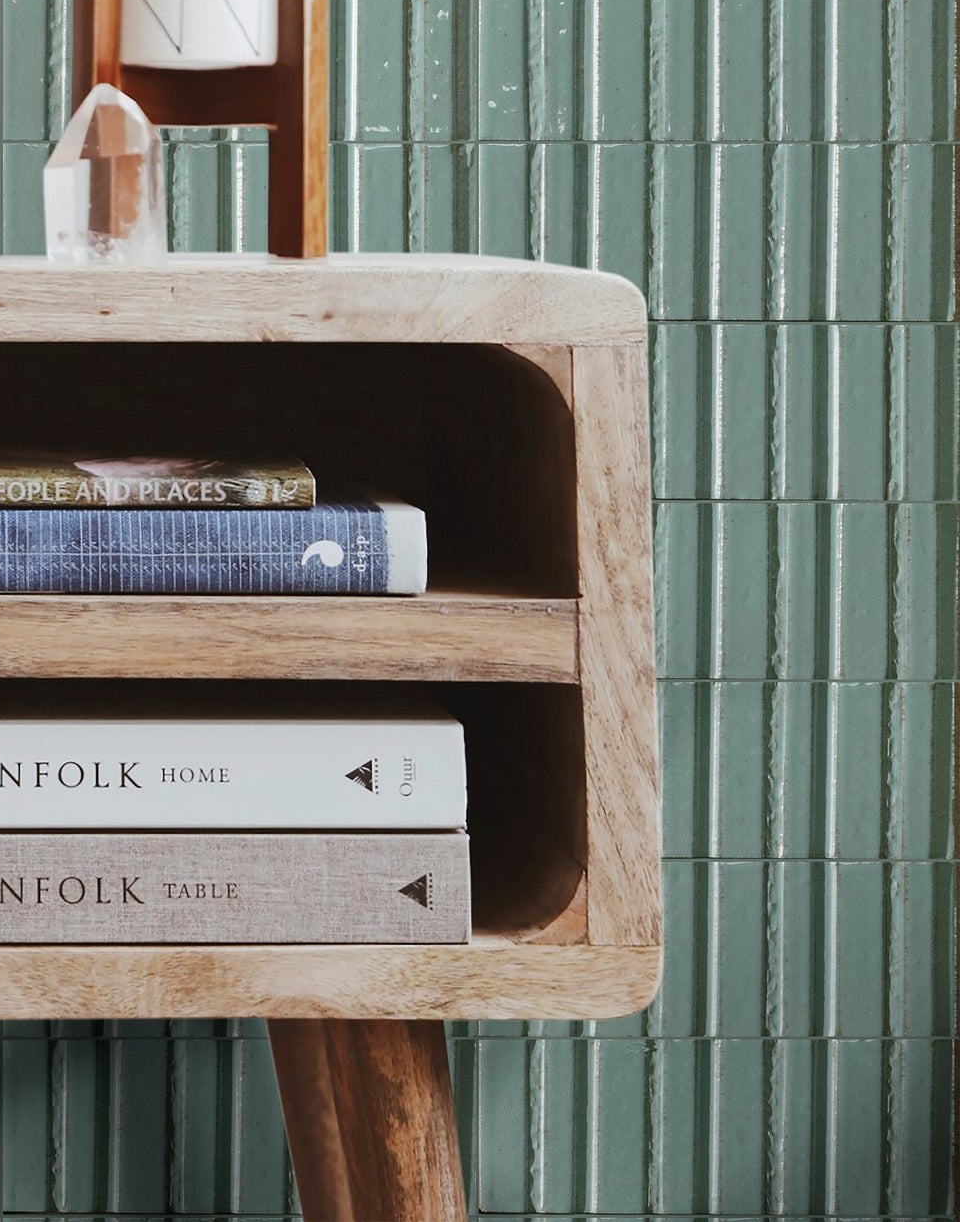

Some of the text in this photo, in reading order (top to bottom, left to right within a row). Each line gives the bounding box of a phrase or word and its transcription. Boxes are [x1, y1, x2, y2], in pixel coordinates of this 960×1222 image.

[75, 480, 130, 503] AND
[139, 480, 227, 503] PLACES
[160, 767, 230, 783] HOME
[399, 755, 414, 797] Ouur
[163, 883, 239, 899] TABLE
